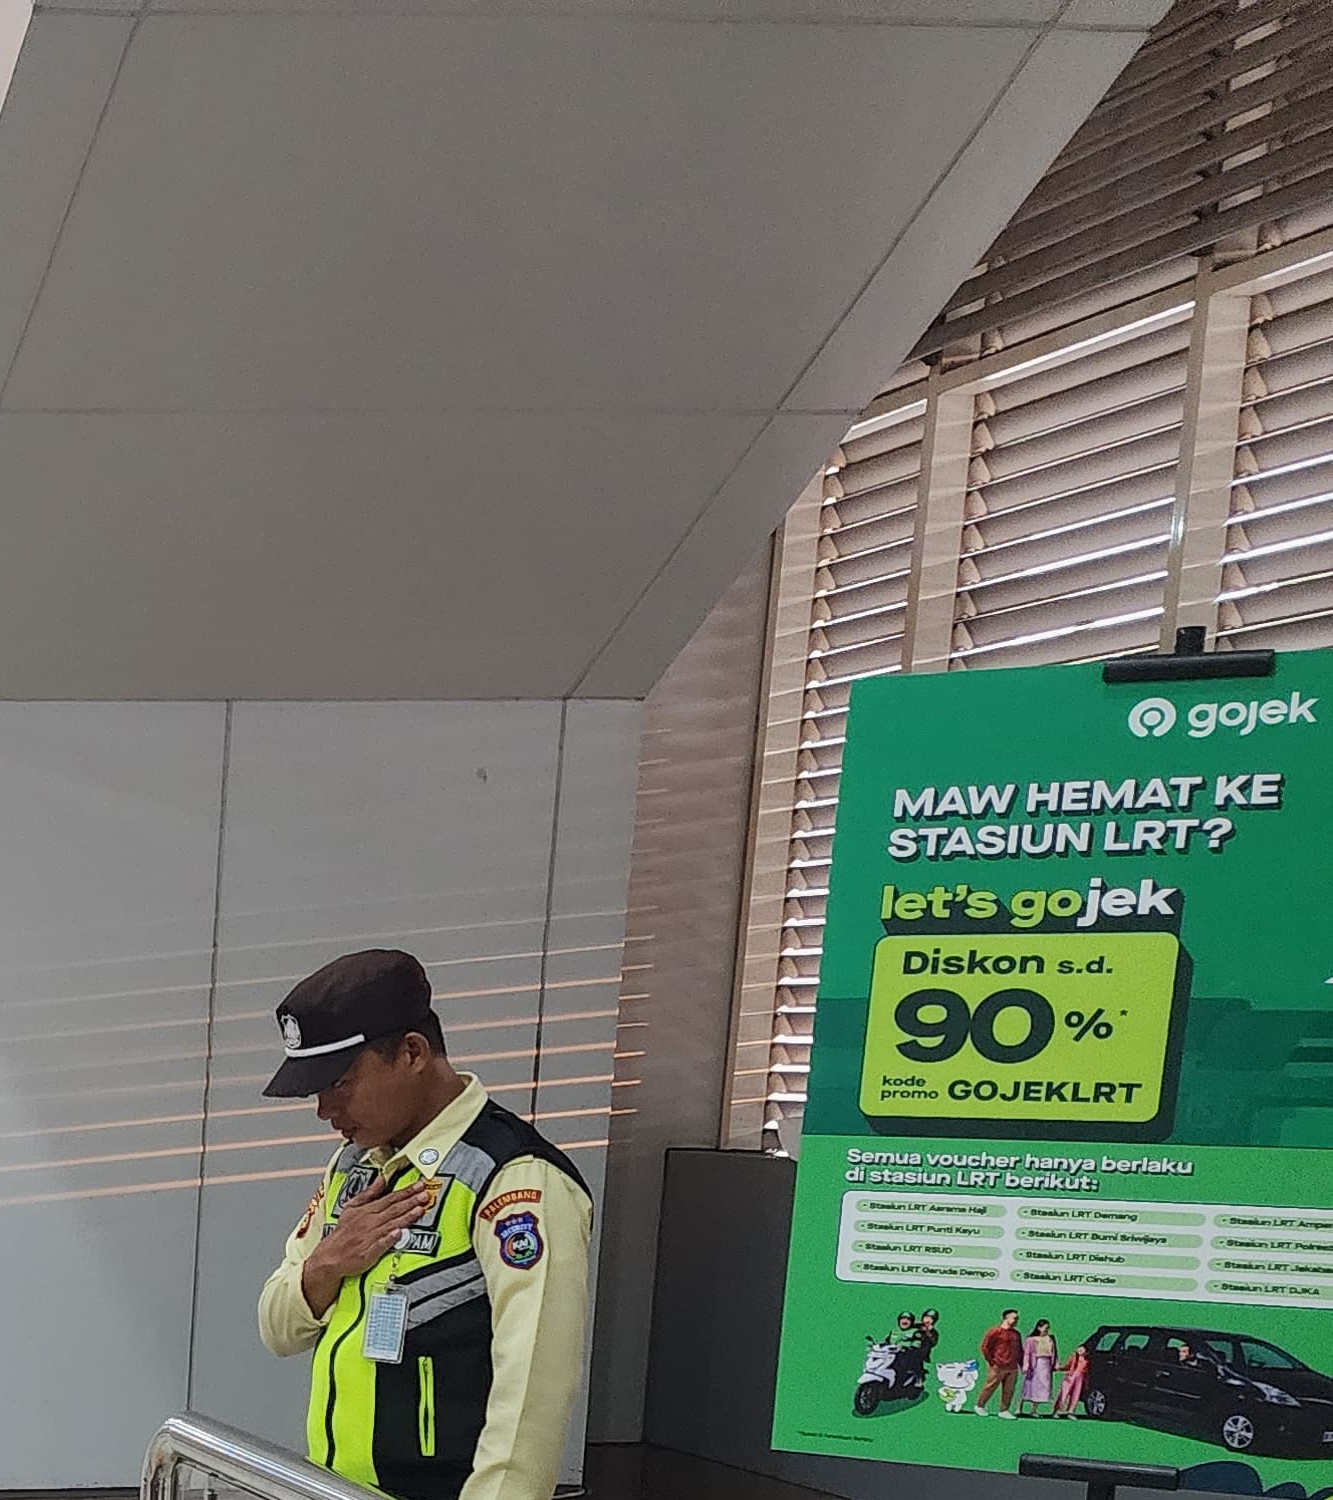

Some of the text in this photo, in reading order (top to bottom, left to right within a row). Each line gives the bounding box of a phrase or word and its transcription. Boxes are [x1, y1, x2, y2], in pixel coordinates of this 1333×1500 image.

[1187, 691, 1320, 738] gojek
[893, 773, 1282, 818] MAW HEMAT KE
[888, 817, 1232, 859] STASIUN LRT?
[881, 877, 1176, 927] let's gojek
[902, 948, 1113, 976] Diskon s.d.
[894, 988, 1055, 1064] 90
[882, 1074, 926, 1088] kode
[881, 1087, 939, 1100] promo
[948, 1079, 1142, 1104] GOJEKLRT
[847, 1149, 1194, 1176] Semua voucher hanya berlaku
[845, 1167, 1099, 1192] di stasiun LRT berikut:
[484, 1190, 537, 1220] PALEMBANG
[870, 1202, 906, 1211] Stasiun
[1031, 1208, 1137, 1222] Stasiun LRT Demang
[1229, 1217, 1296, 1227] Stasiun LRT
[867, 1223, 904, 1231] Stasiun
[906, 1224, 925, 1232] LRT
[927, 1226, 953, 1234] Punti
[1028, 1229, 1066, 1239] Stasiun
[1069, 1231, 1089, 1240] LRT
[1091, 1232, 1118, 1241] Bumi
[865, 1243, 953, 1254] Stasiun LRT RSUD
[1226, 1239, 1293, 1249] Stasiun LRT
[1026, 1251, 1125, 1263] Stasiun LRT Dishub
[863, 1263, 900, 1272] Stasiun
[901, 1265, 920, 1273] LRT
[960, 1268, 995, 1278] Dempo
[1224, 1261, 1290, 1271] Stasiun LRT
[1024, 1272, 1116, 1284] Stasiun LRT Cinde
[1221, 1283, 1320, 1295] Stasiun LRT DJKA
